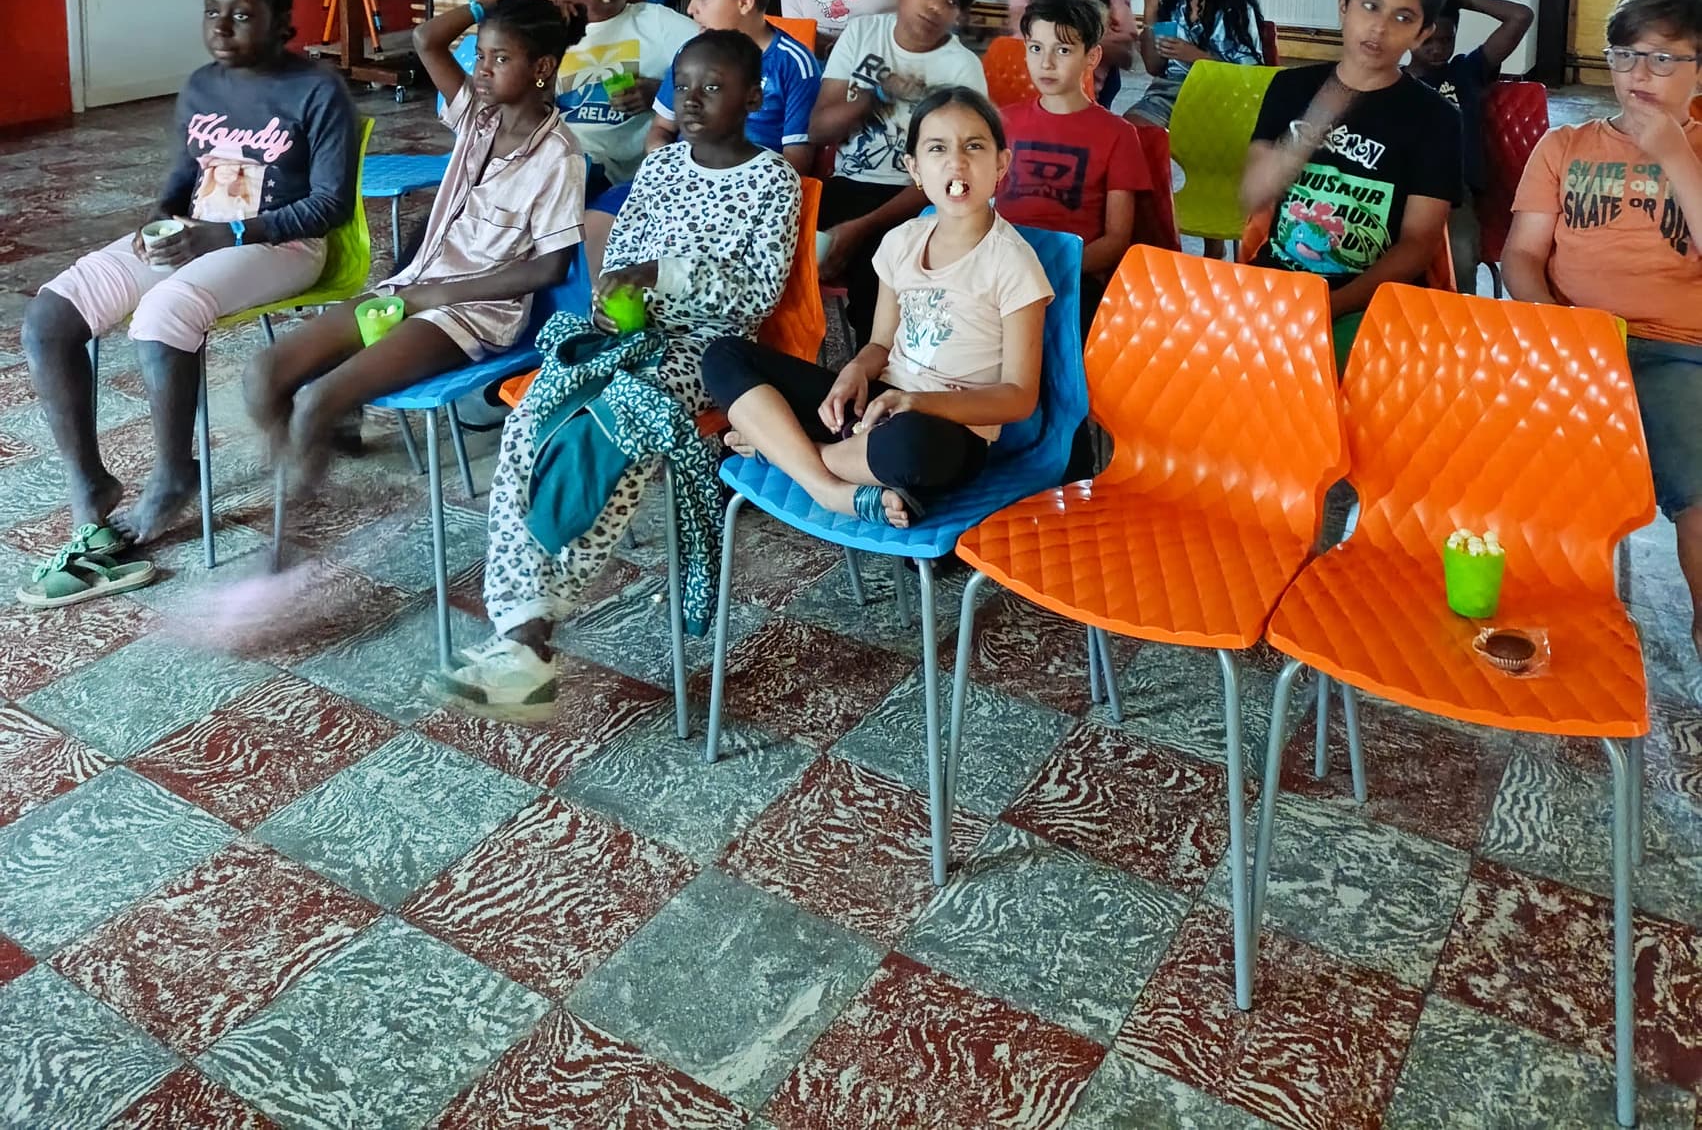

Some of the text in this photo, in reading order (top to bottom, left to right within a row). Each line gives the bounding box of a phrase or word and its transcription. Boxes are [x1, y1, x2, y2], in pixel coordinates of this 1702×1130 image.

[577, 106, 625, 122] RELAX
[187, 113, 294, 163] Howdy
[1567, 159, 1662, 182] SKATE OR
[1564, 173, 1626, 198] SKATE
[1564, 190, 1623, 229] SKATE
[1629, 197, 1657, 223] OR
[1659, 196, 1692, 257] DI
